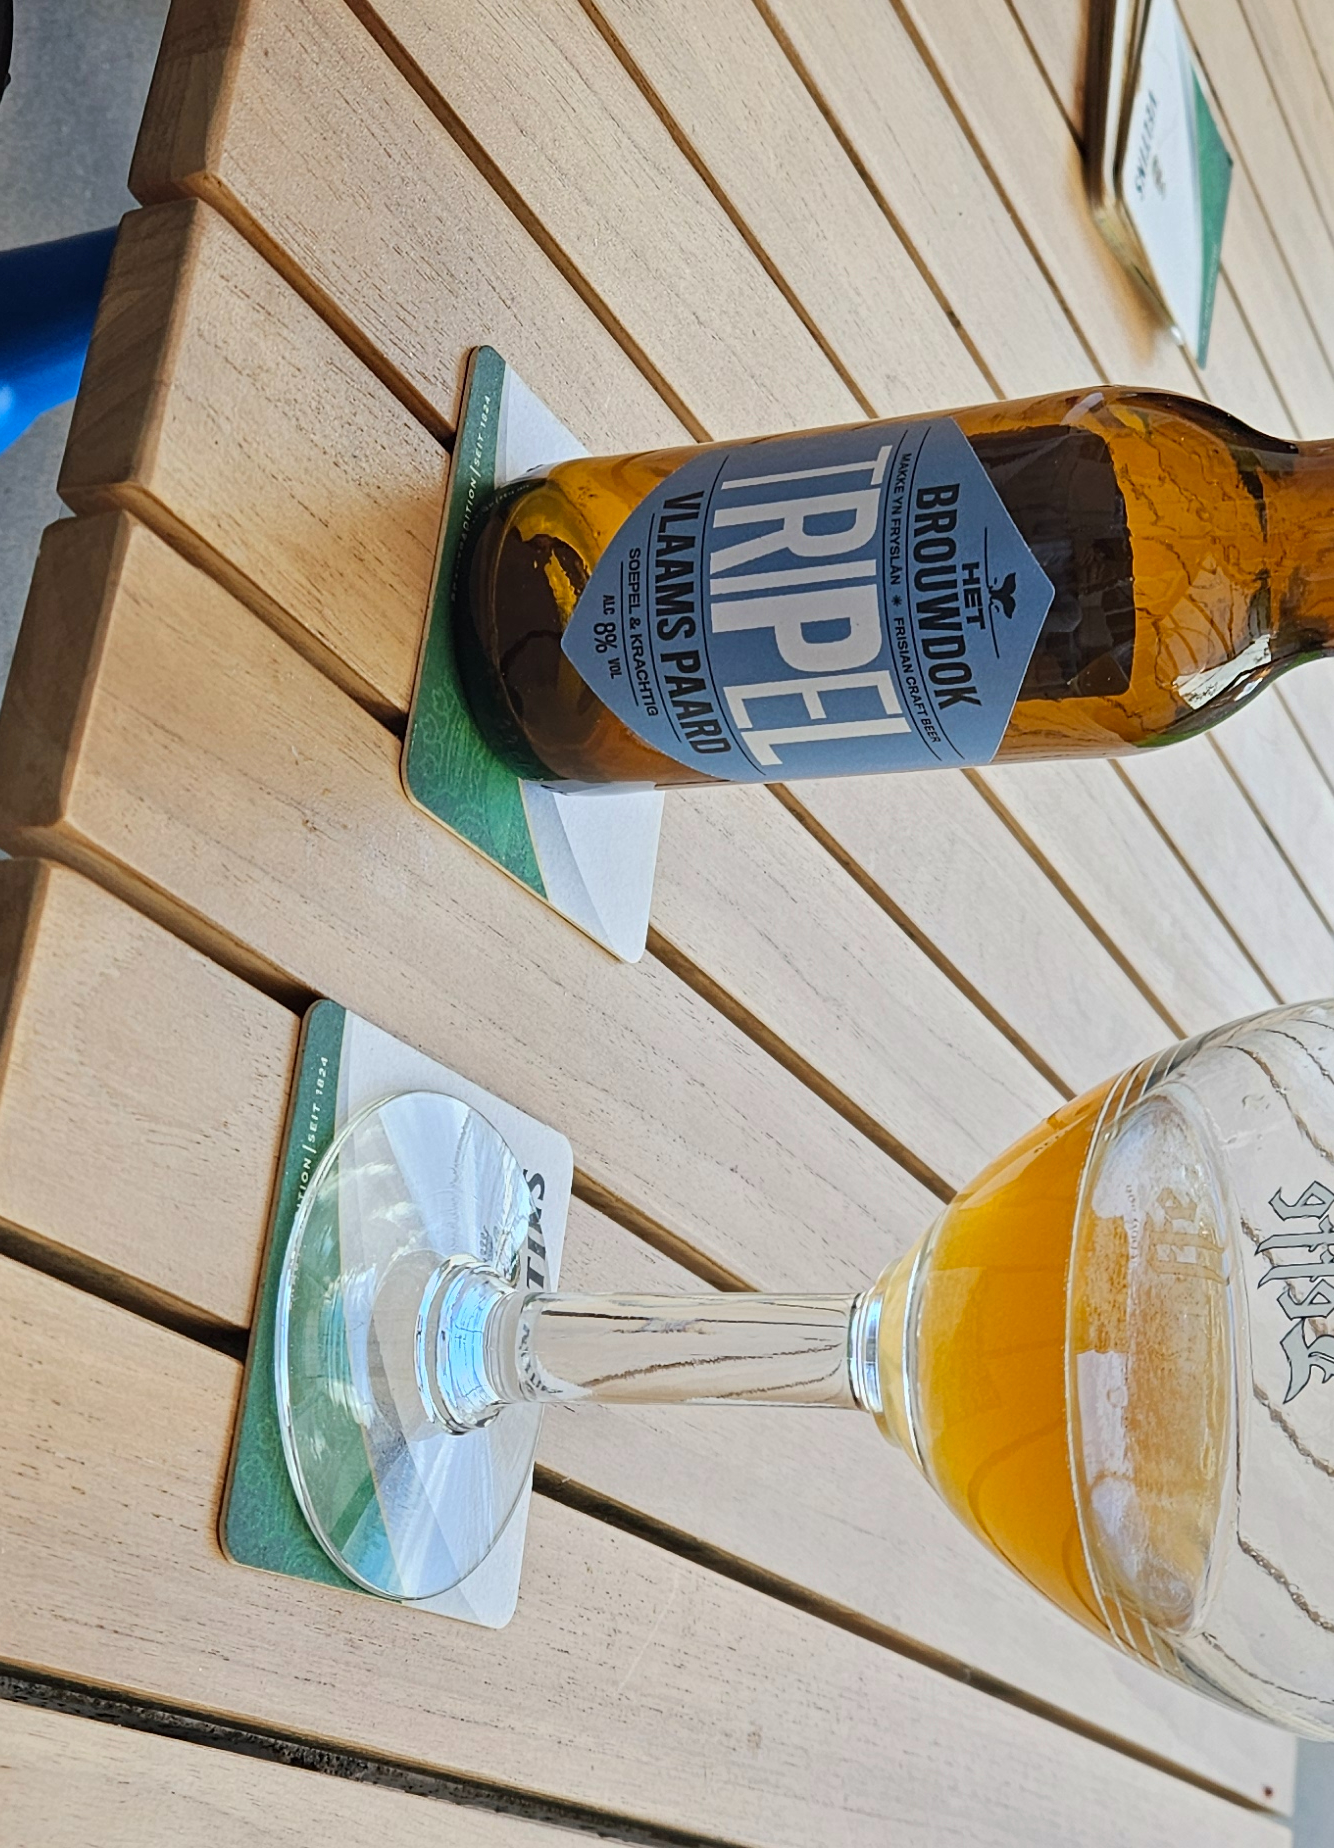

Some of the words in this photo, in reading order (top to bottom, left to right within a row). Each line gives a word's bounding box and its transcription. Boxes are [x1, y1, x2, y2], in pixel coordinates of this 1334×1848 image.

[473, 433, 486, 467] SEIT
[892, 453, 912, 495] MAKKE
[891, 496, 903, 516] YN
[628, 547, 641, 612] SOEPEL
[654, 490, 705, 641] VLAAMS
[890, 517, 901, 585] FRYSLÂN
[603, 594, 615, 615] ALC
[629, 616, 641, 628] &
[709, 445, 912, 766] TRIPEL
[913, 482, 982, 710] BROUWDOK
[962, 561, 985, 630] HET
[594, 622, 617, 654] 8%
[608, 658, 619, 679] VOL
[629, 635, 658, 717] KRACHTIG
[663, 649, 731, 755] PAARD
[894, 617, 914, 674] FRISIAN
[905, 674, 926, 716] CRAFT
[920, 713, 942, 744] BEER
[307, 1103, 321, 1143] SEIT
[315, 1056, 330, 1095] 1824
[523, 1169, 546, 1290] TINS
